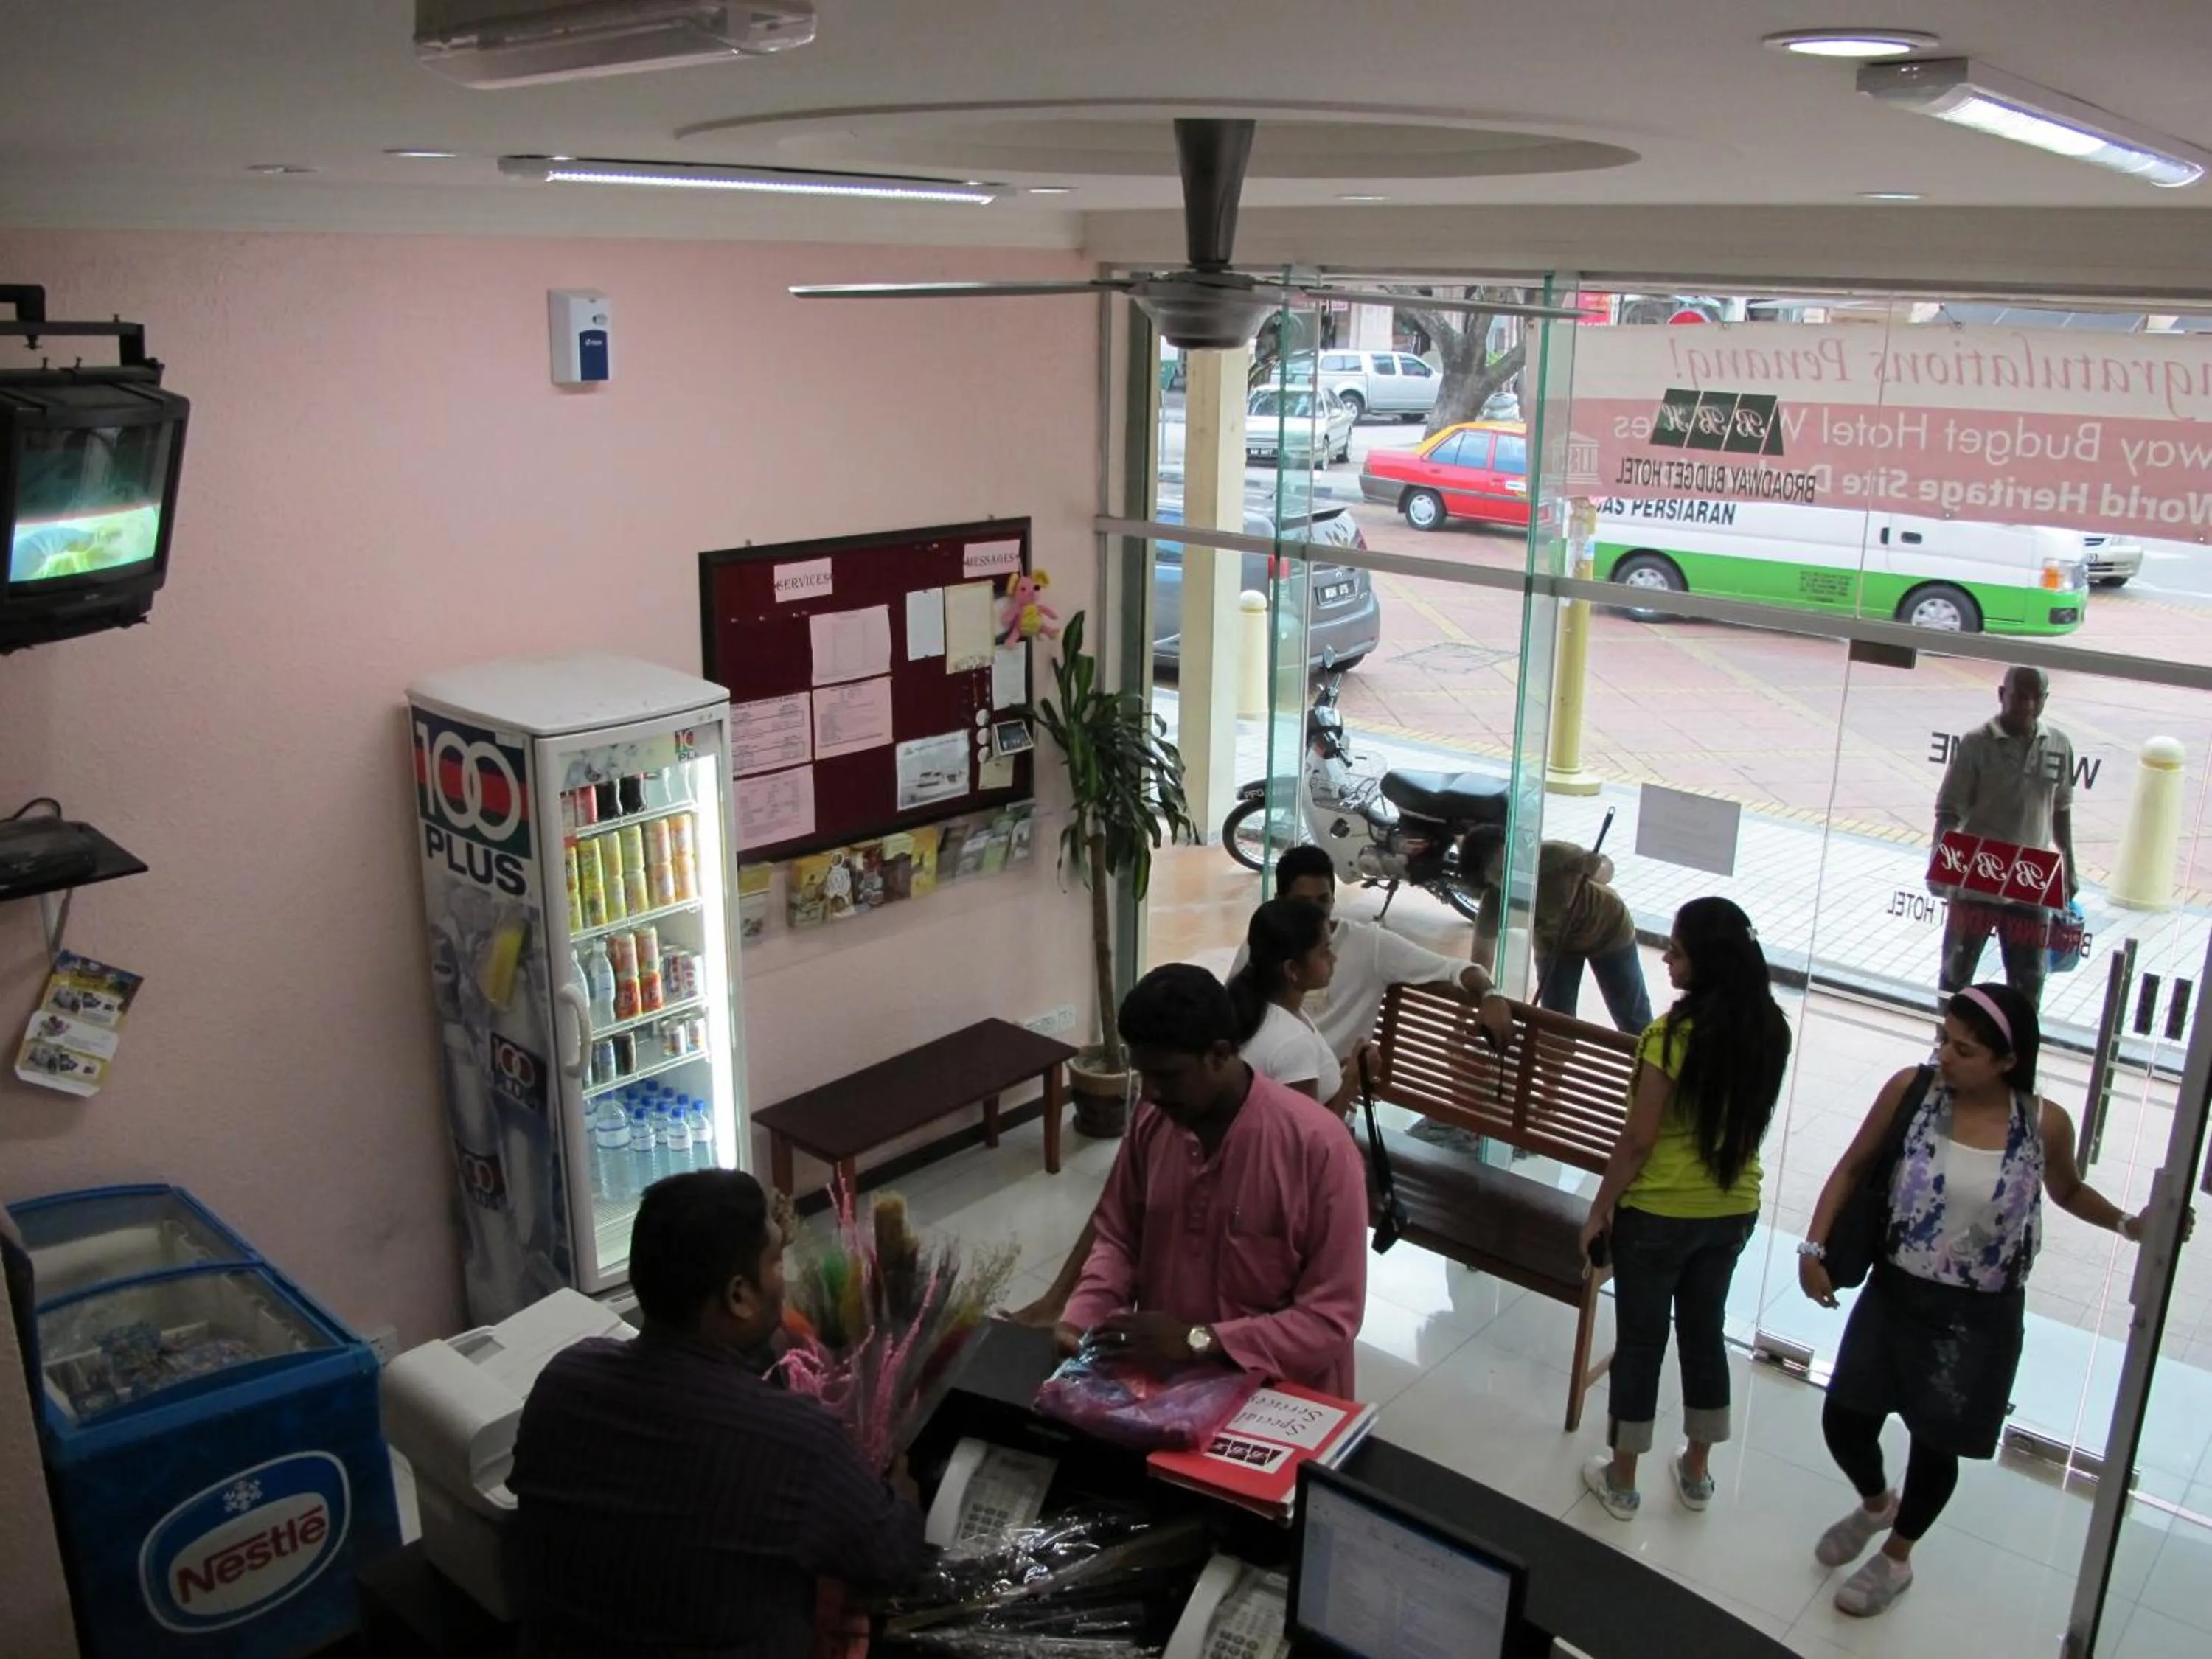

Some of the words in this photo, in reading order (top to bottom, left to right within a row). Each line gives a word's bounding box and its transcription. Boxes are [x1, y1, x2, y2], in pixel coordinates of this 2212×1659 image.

[1630, 498, 1736, 525] PERSIARAN
[776, 573, 830, 592] SERVICES
[966, 554, 1016, 567] MESSAGES
[415, 720, 522, 842] 100
[425, 824, 527, 897] PLUS
[176, 1504, 326, 1604] Nestlé
